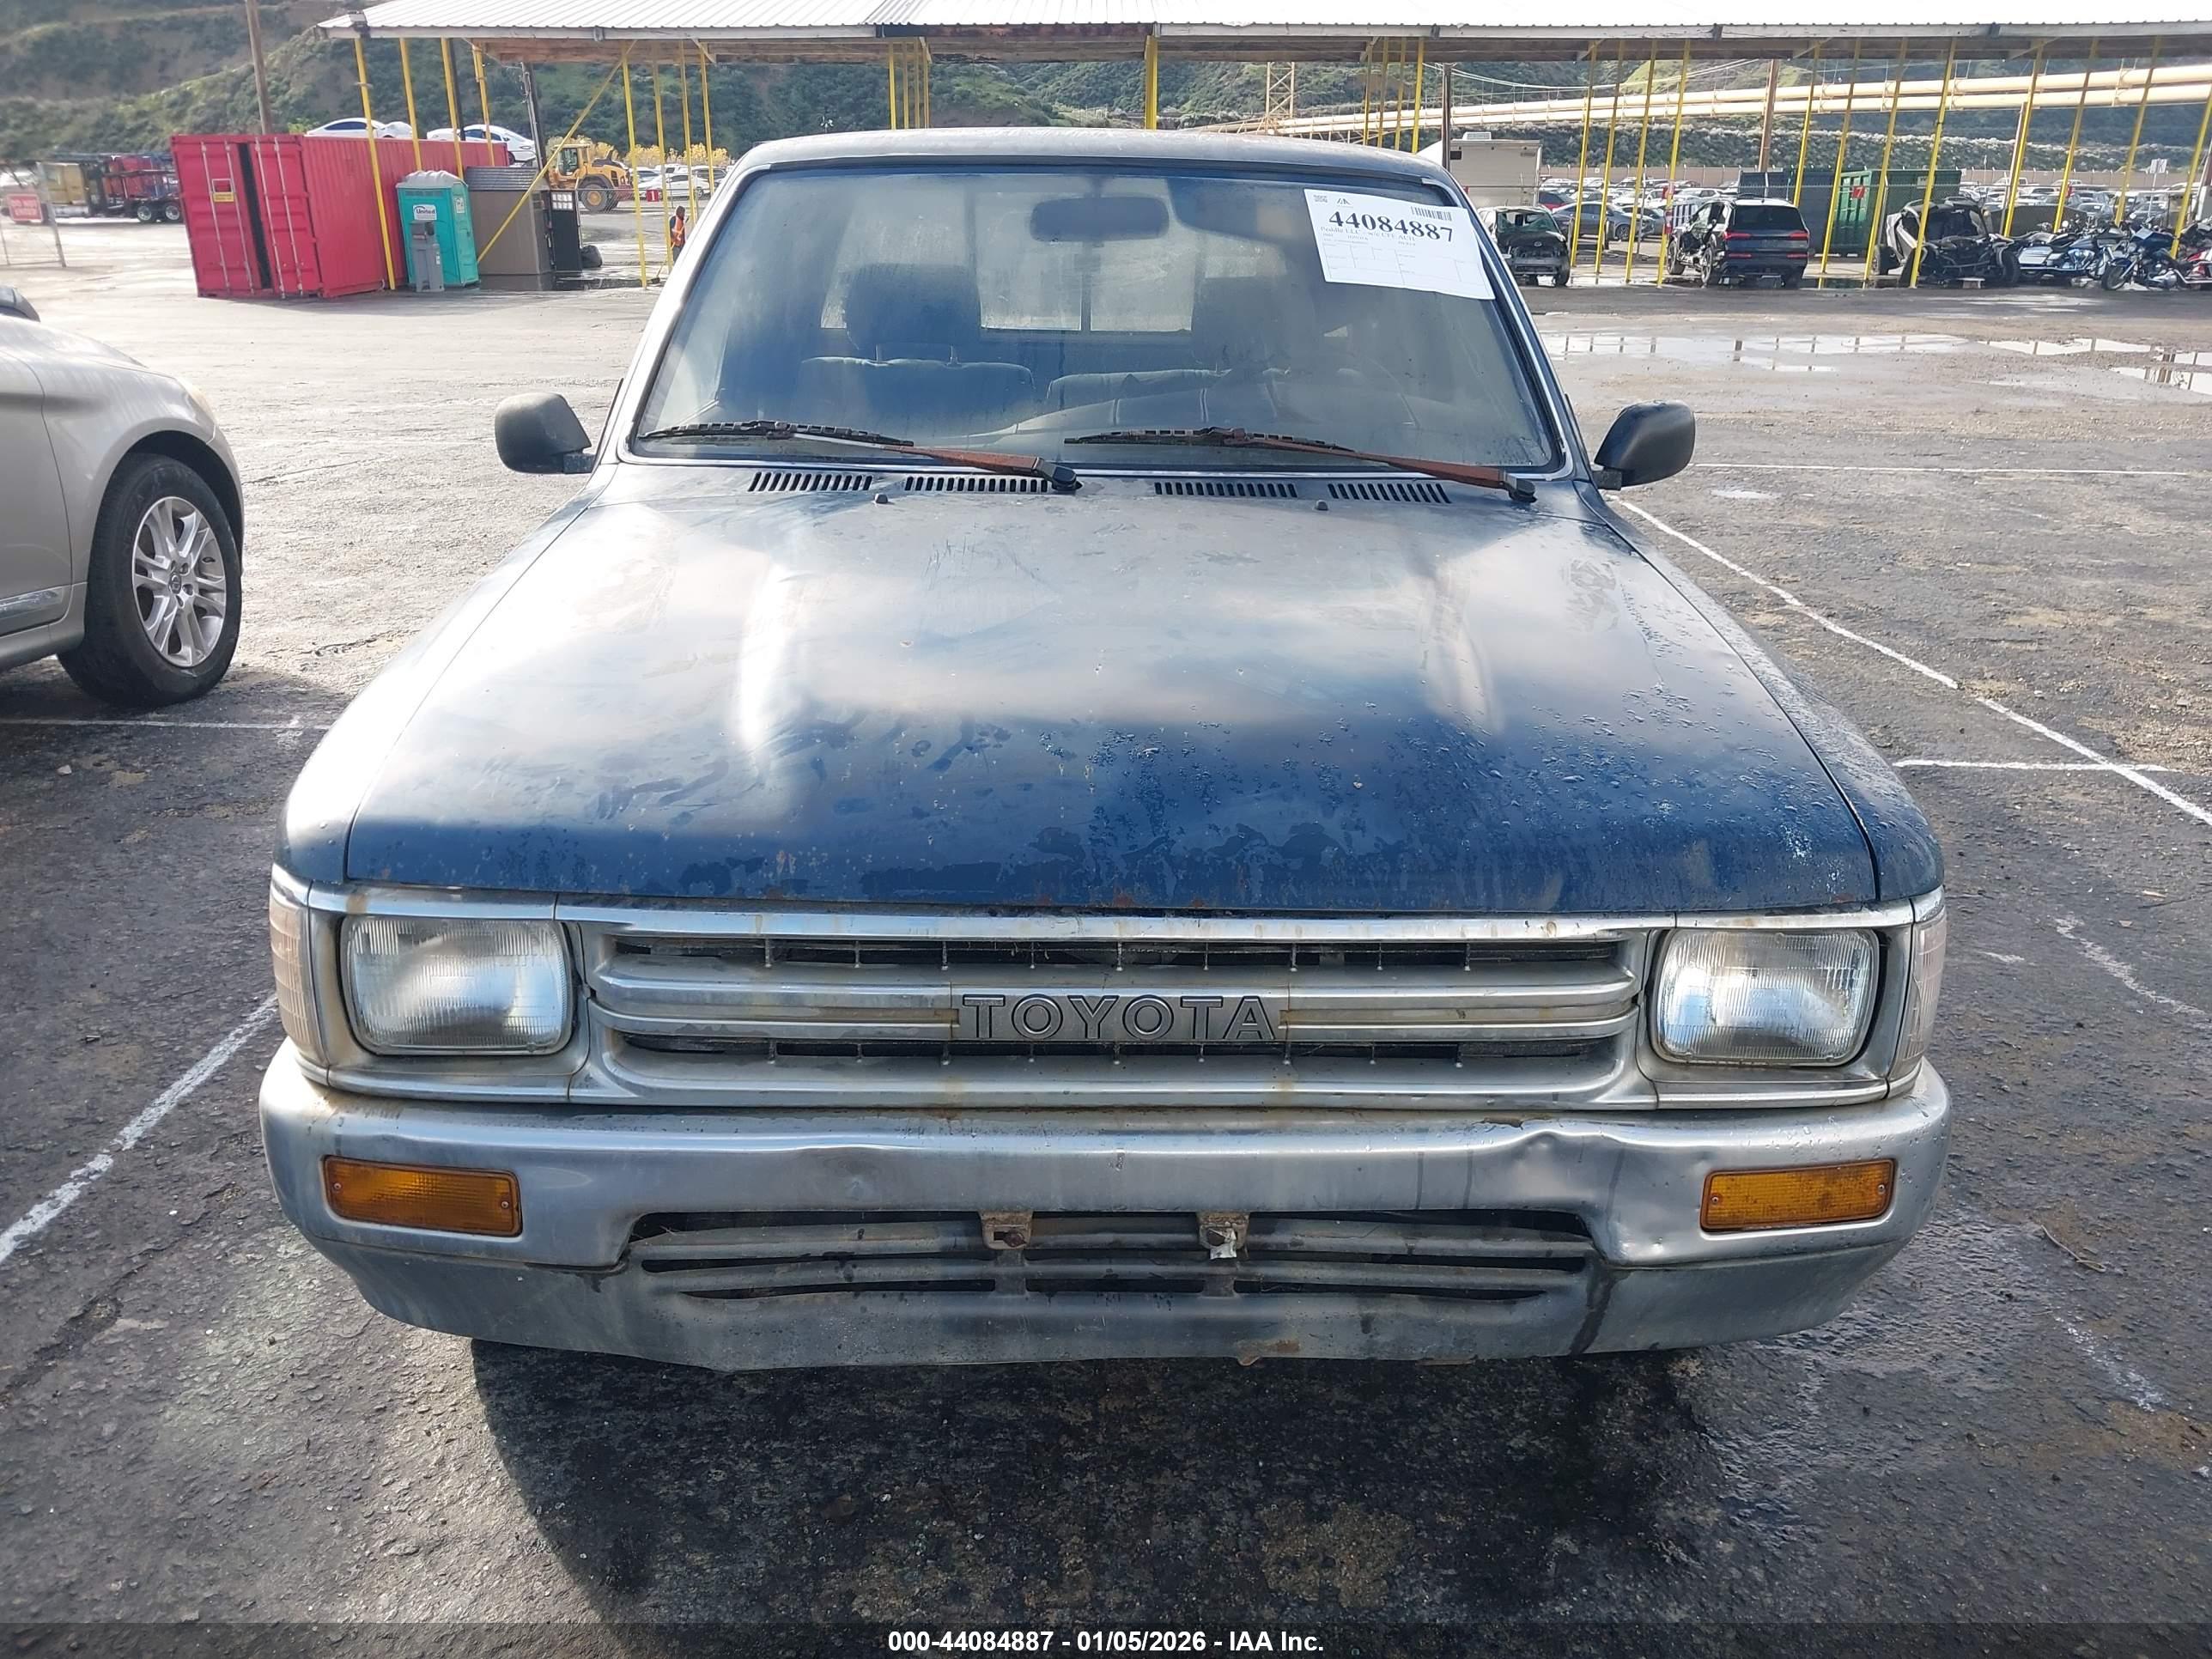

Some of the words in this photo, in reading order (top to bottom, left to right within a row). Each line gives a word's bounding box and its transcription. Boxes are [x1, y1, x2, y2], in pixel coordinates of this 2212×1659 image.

[650, 189, 656, 201] 1
[1854, 186, 1863, 198] 7
[1328, 210, 1454, 243] 44084887
[962, 993, 1277, 1040] TOYOTA
